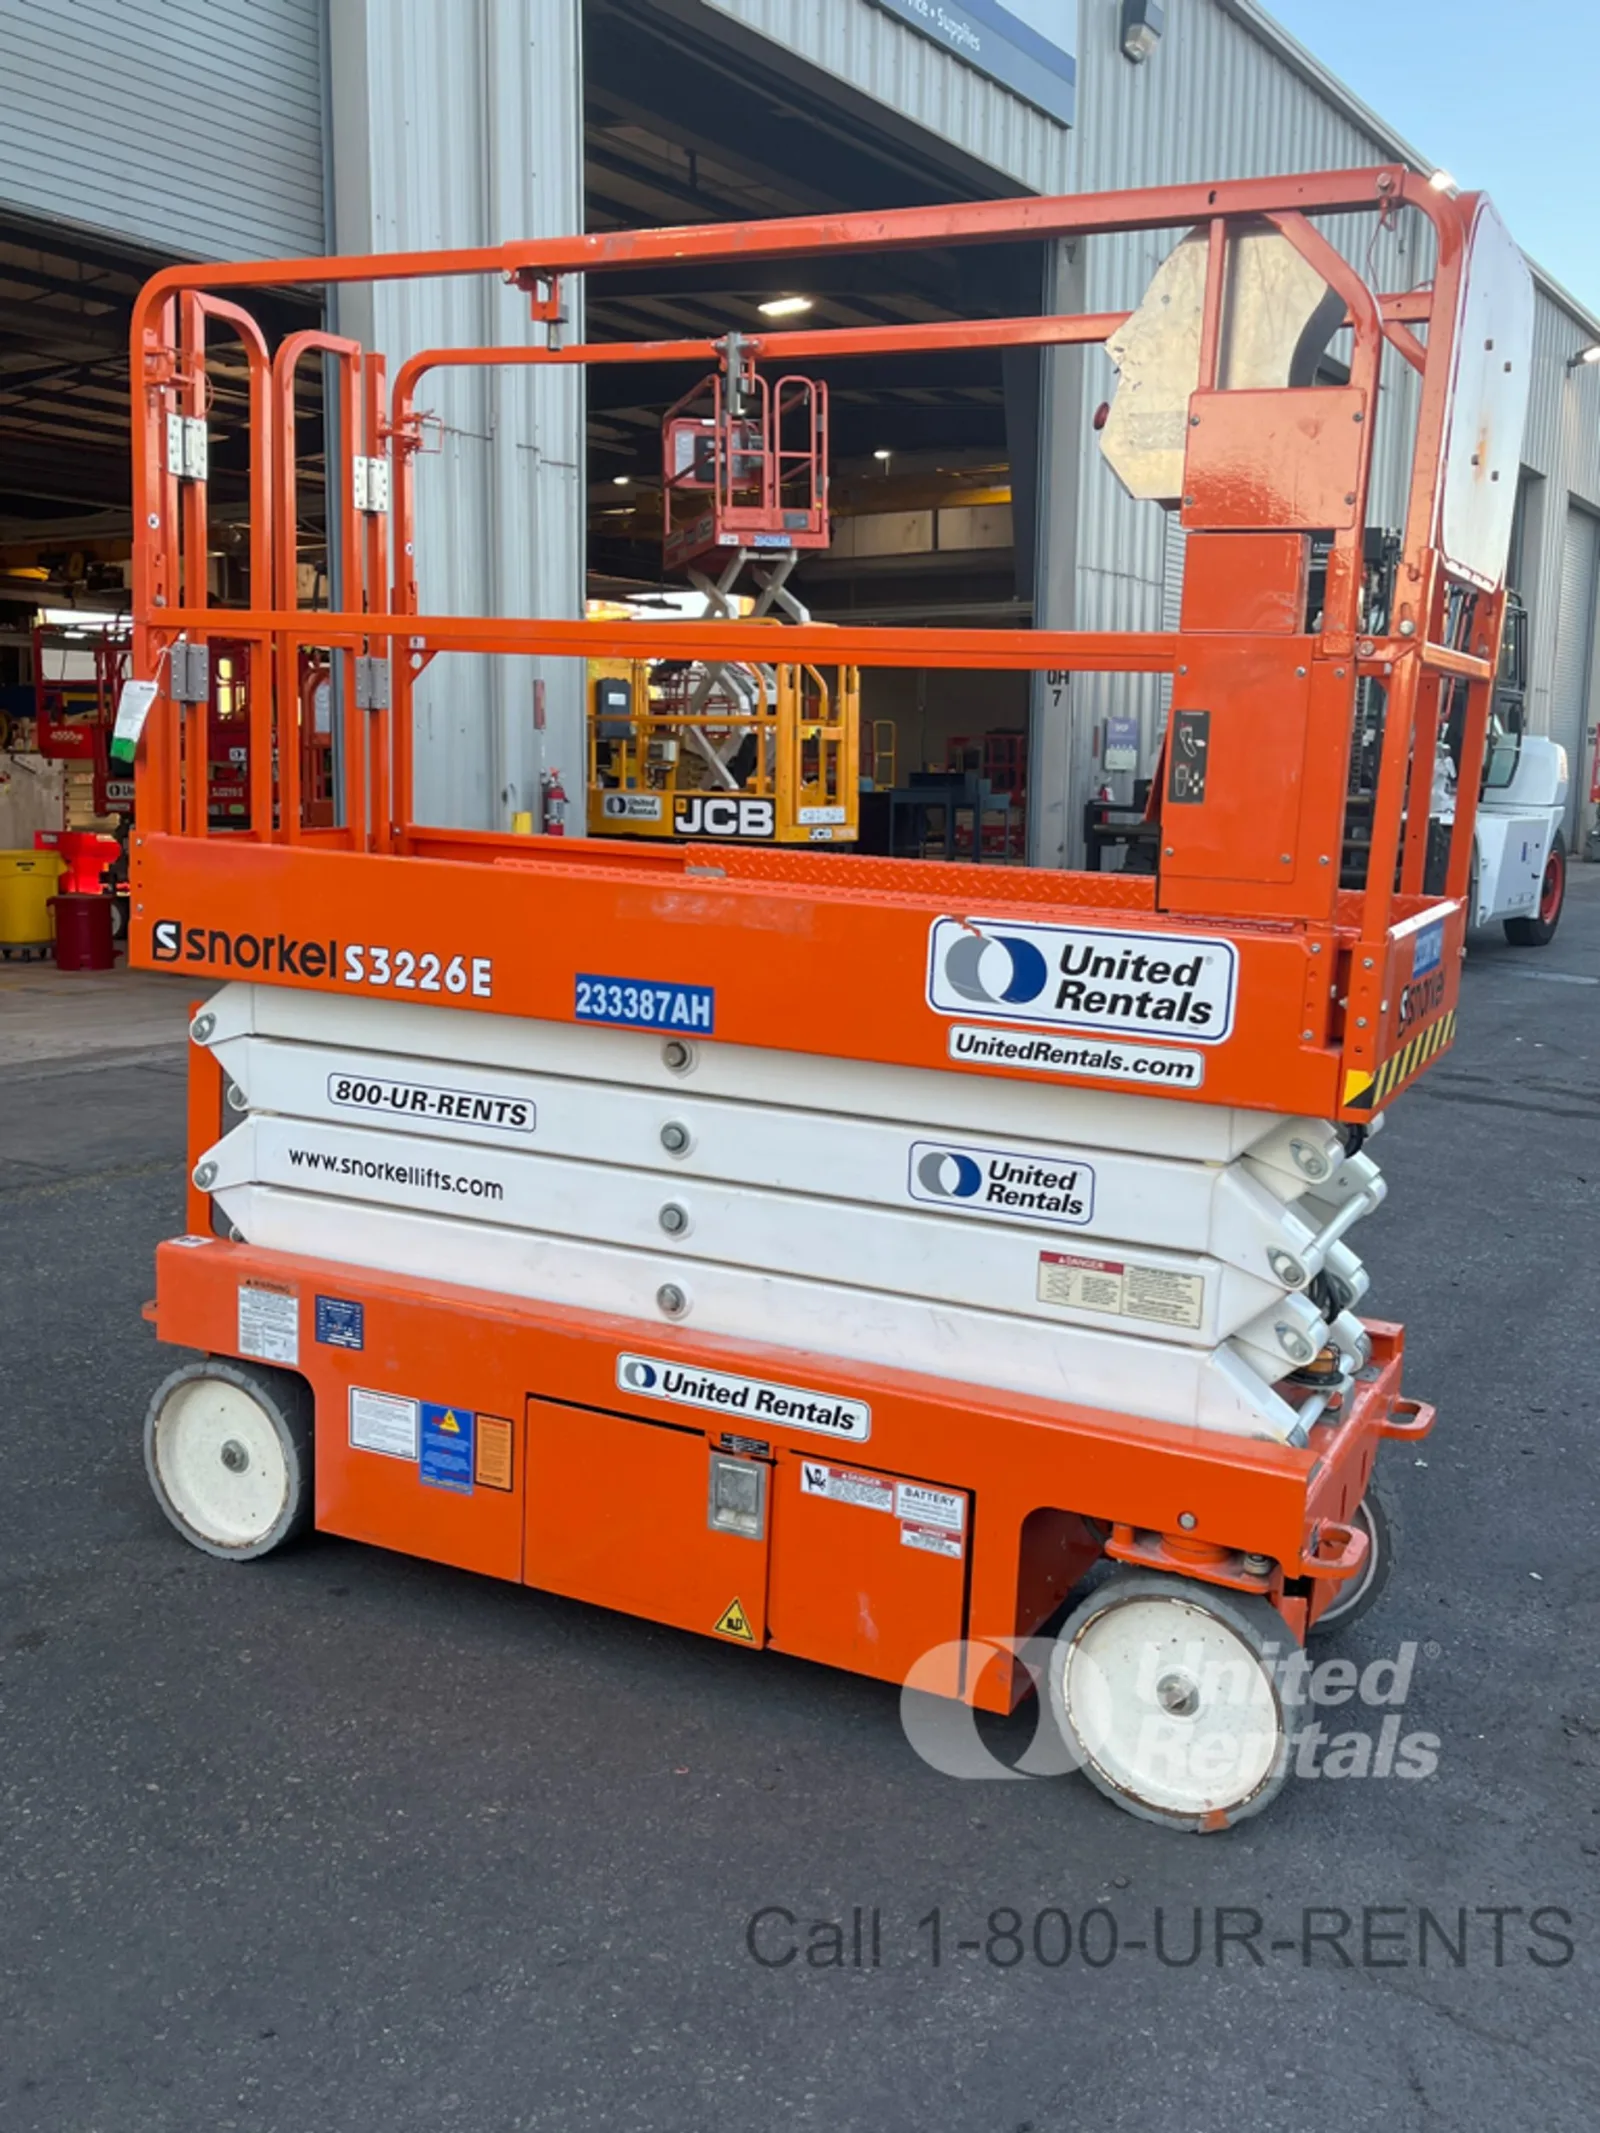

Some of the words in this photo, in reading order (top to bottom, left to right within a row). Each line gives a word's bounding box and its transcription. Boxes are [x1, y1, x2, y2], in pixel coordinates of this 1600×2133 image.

[937, 7, 980, 52] Supplies
[1052, 689, 1062, 707] 7
[675, 798, 774, 836] JCB
[186, 928, 337, 979] snorkel
[344, 945, 493, 998] S3226E
[1059, 944, 1204, 987] United
[575, 981, 710, 1027] 233387AH
[1055, 979, 1213, 1025] Rentals
[955, 1033, 1195, 1080] UnitedRentals.com
[335, 1080, 528, 1126] 800-UR-RENTS
[288, 1148, 504, 1200] www.snorkellifts.com
[988, 1160, 1077, 1191] United
[986, 1183, 1083, 1215] Rentals
[1066, 1257, 1106, 1270] DANGER
[662, 1370, 750, 1408] United
[754, 1389, 855, 1430] Rentals
[904, 1487, 956, 1507] BATTERY
